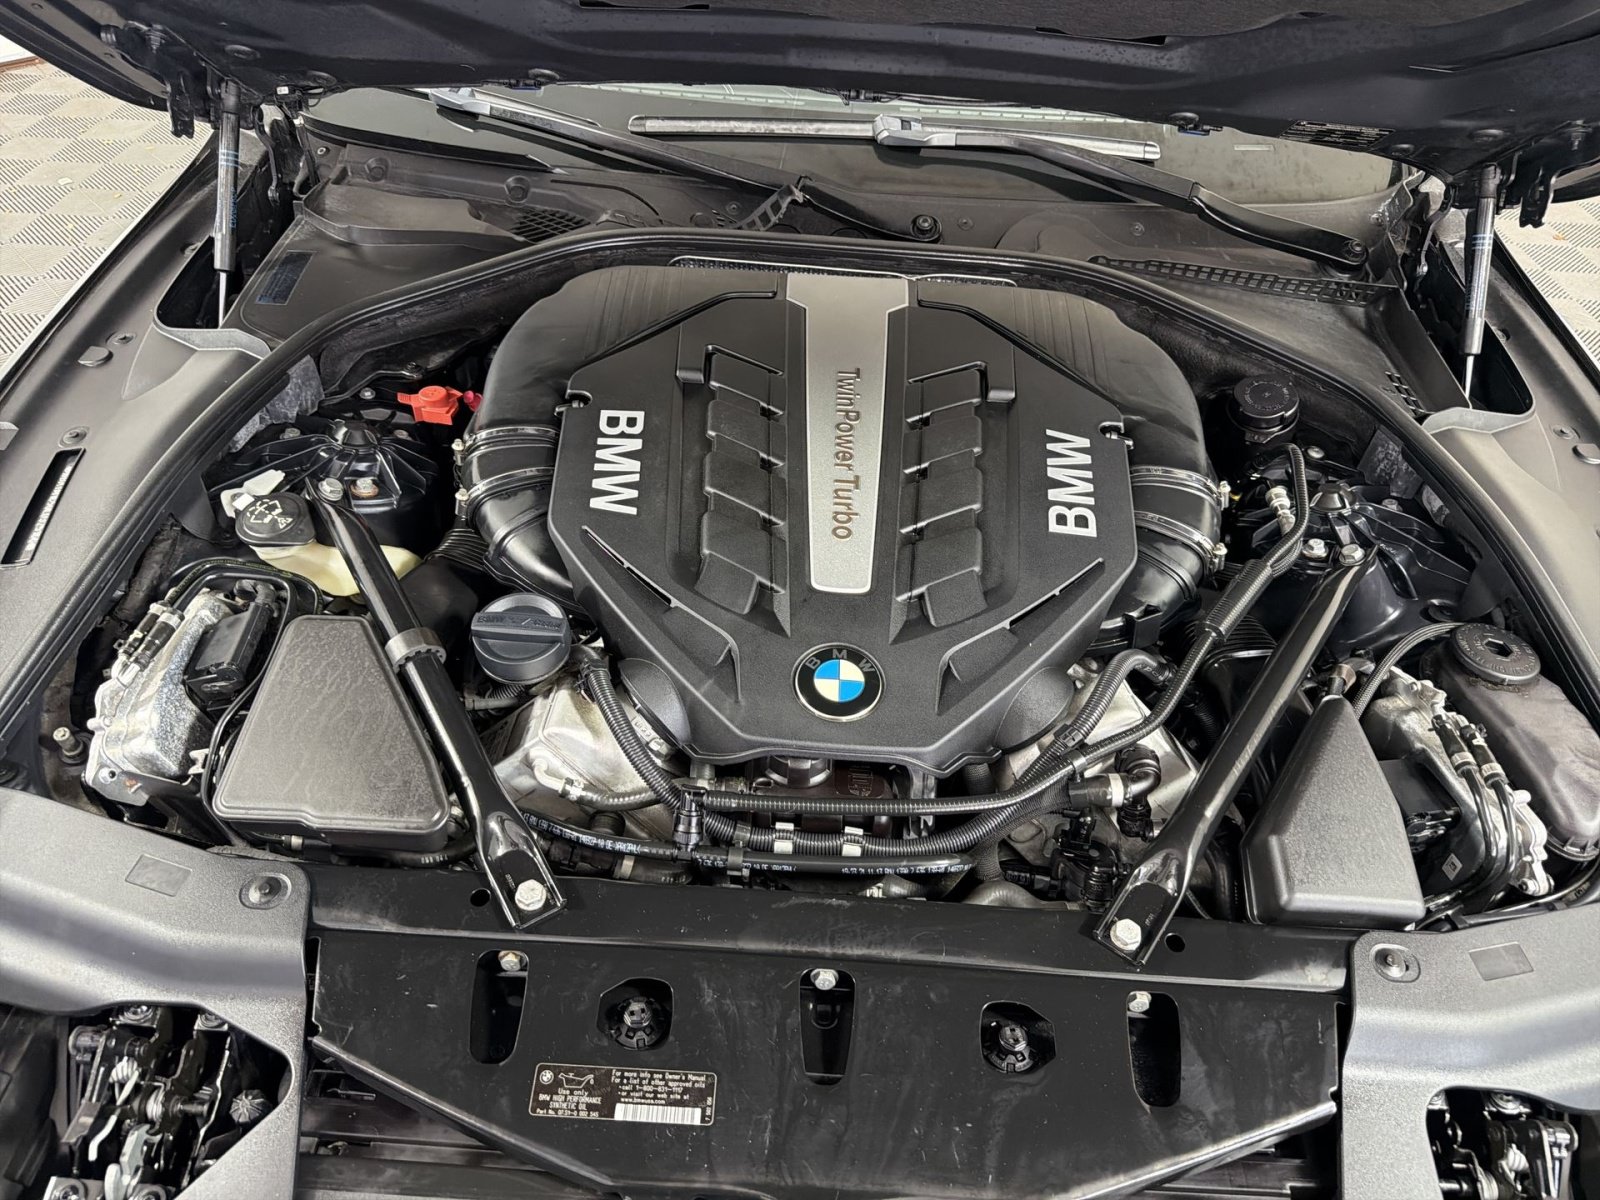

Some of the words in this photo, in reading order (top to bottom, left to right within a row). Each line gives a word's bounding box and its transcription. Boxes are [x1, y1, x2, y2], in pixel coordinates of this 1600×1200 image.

[835, 366, 863, 473] TwinPower
[588, 408, 646, 516] BMW
[1044, 429, 1099, 538] BMW
[830, 474, 861, 541] Turbo
[804, 648, 876, 673] BMW
[566, 1094, 602, 1104] PERFORMANCE
[665, 1072, 685, 1080] Owner's
[549, 1101, 577, 1110] SYNTHETIC
